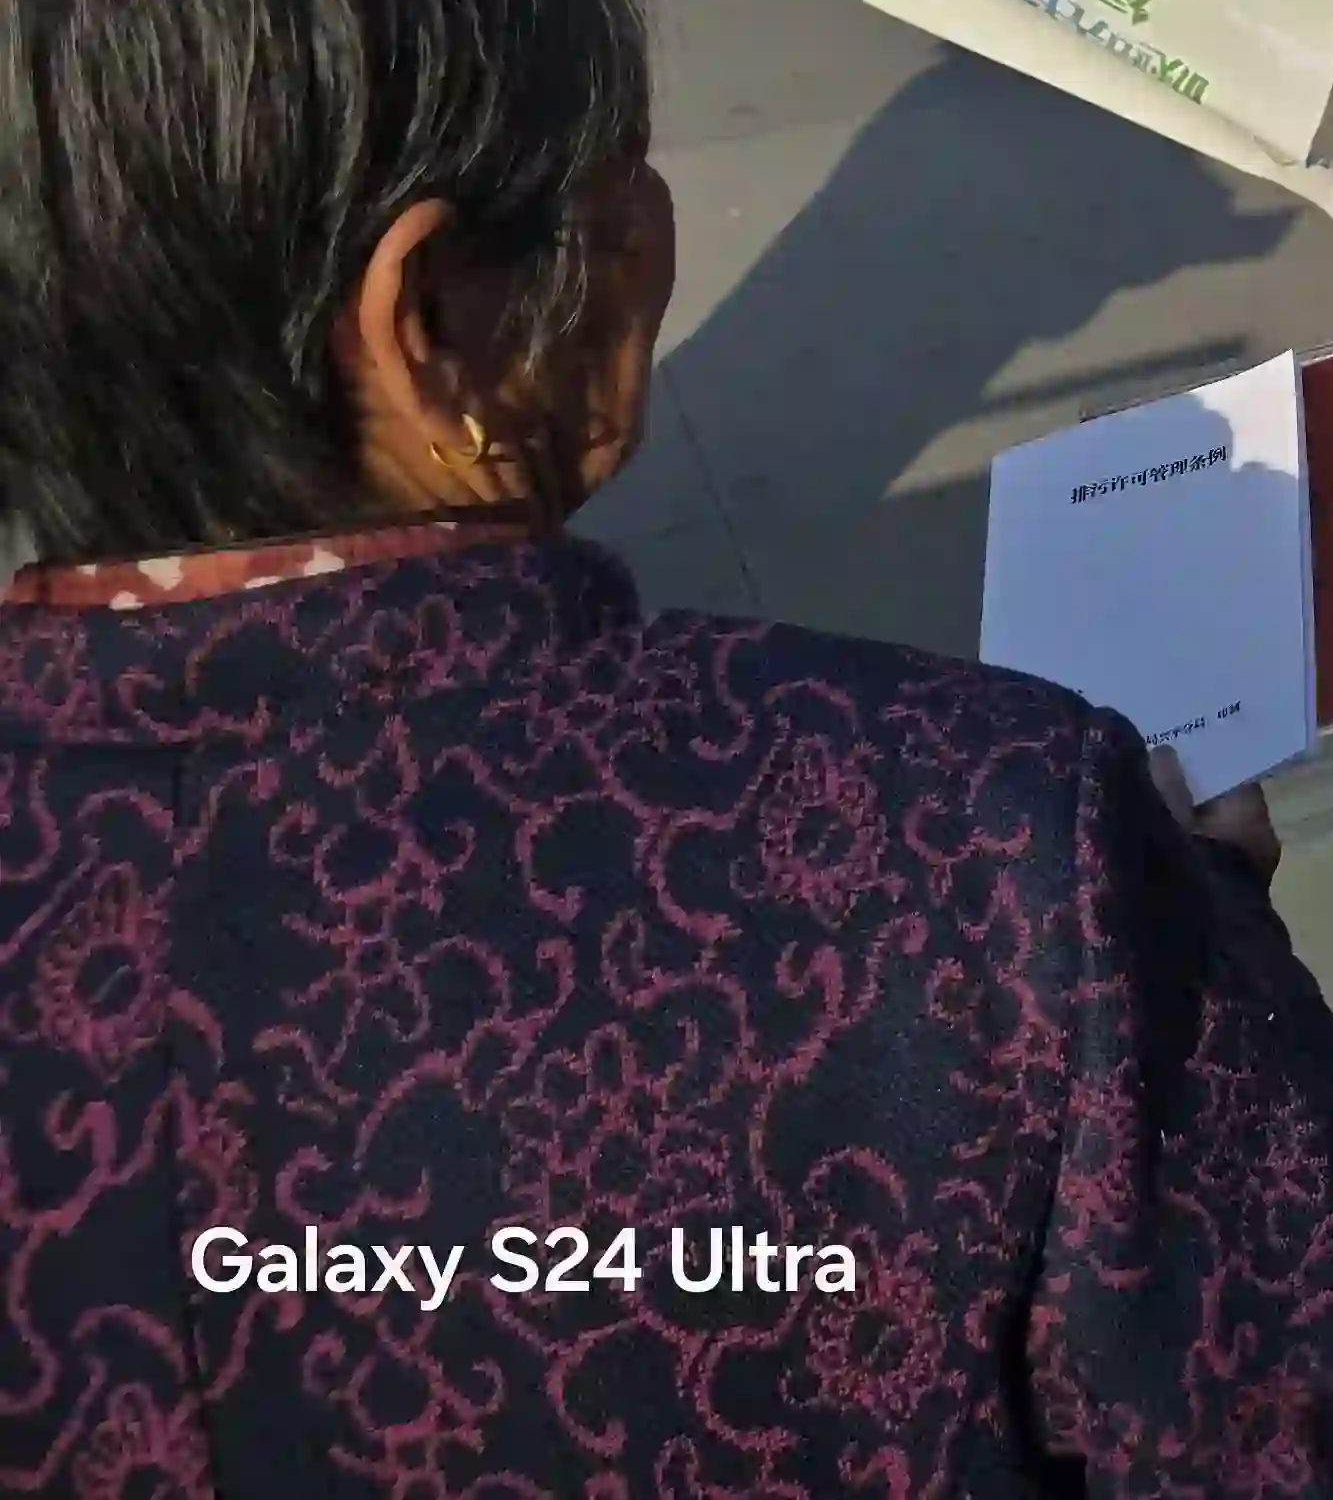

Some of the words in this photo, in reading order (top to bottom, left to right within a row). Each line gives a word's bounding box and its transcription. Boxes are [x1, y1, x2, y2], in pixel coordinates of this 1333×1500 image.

[1071, 445, 1227, 503] 排污许可管理条例
